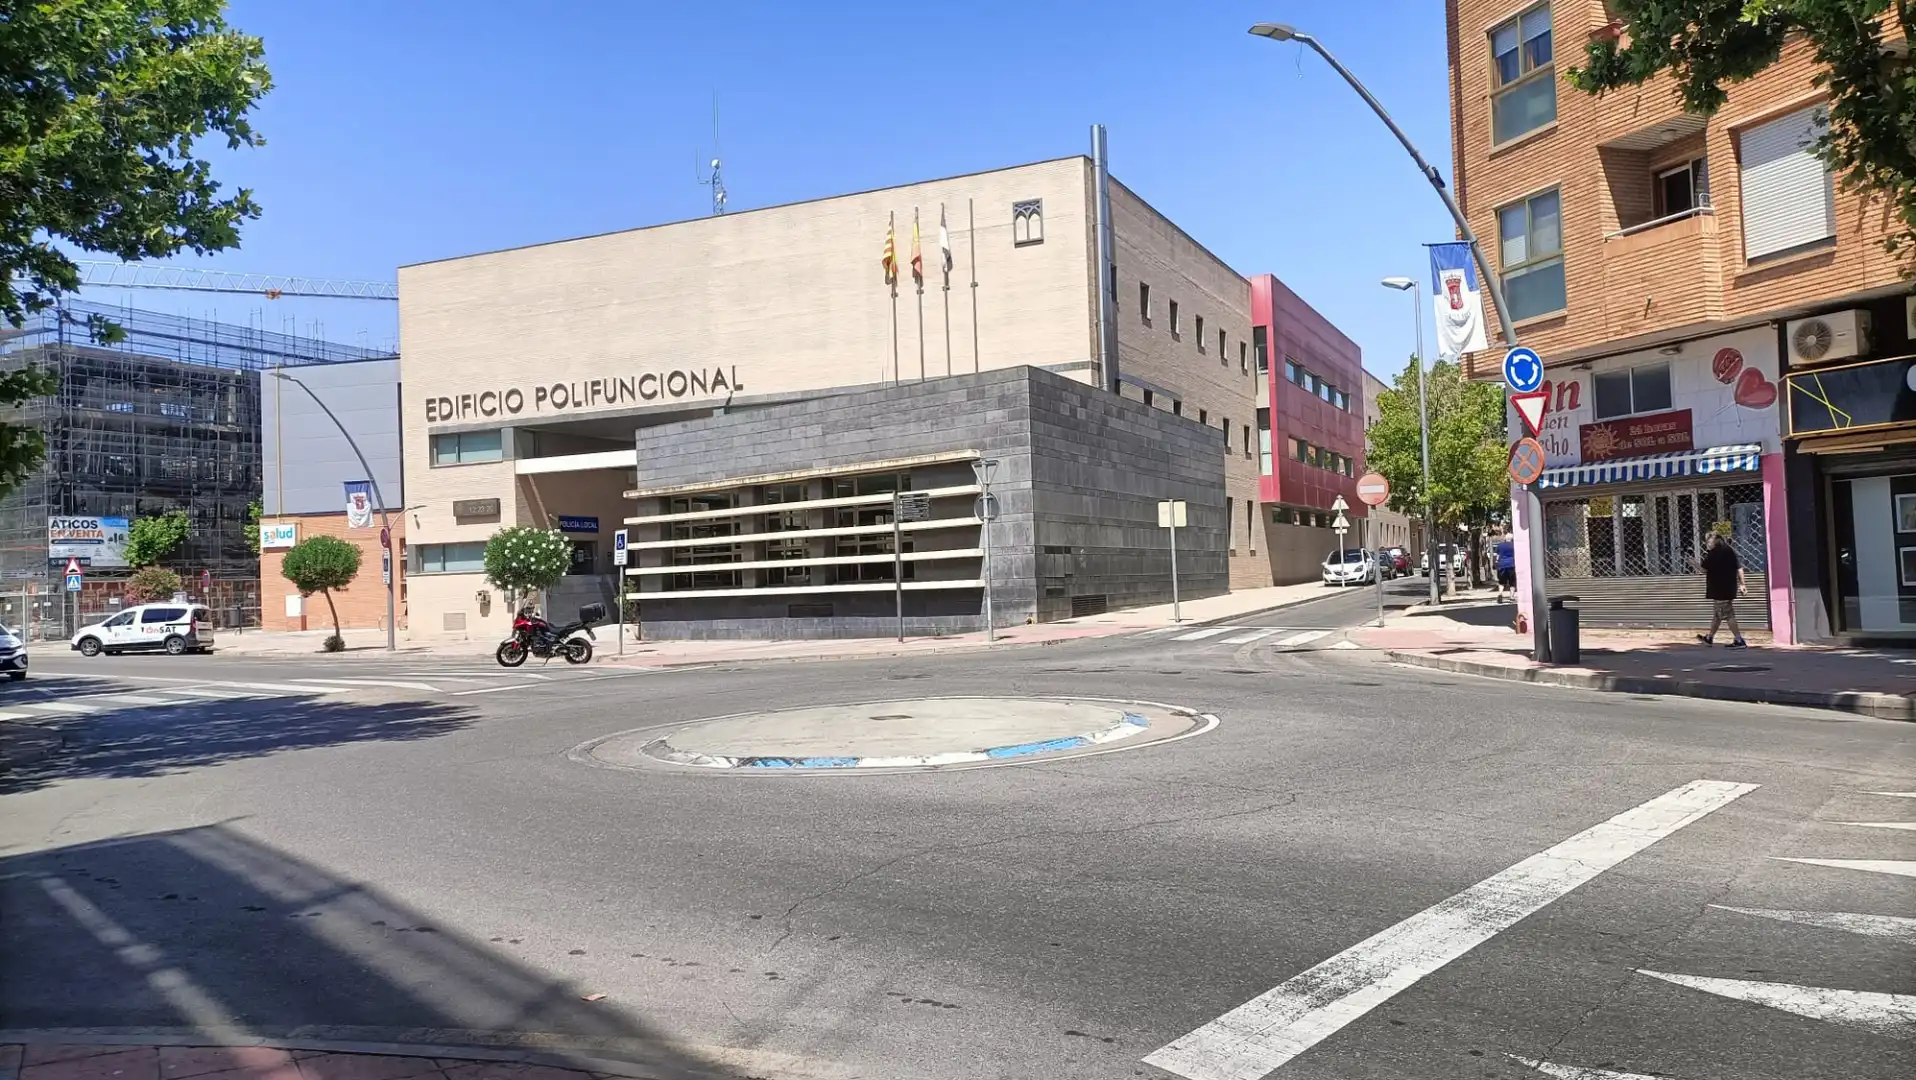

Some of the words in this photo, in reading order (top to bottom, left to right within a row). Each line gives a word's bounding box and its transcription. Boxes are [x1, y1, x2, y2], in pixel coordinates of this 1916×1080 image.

[426, 388, 524, 422] EDIFICIO
[535, 365, 744, 412] POLIFUNCIONAL
[1540, 415, 1569, 431] ien
[1667, 431, 1690, 444] SOL
[50, 529, 67, 539] EN
[70, 529, 105, 539] VENTA
[263, 527, 294, 540] salud
